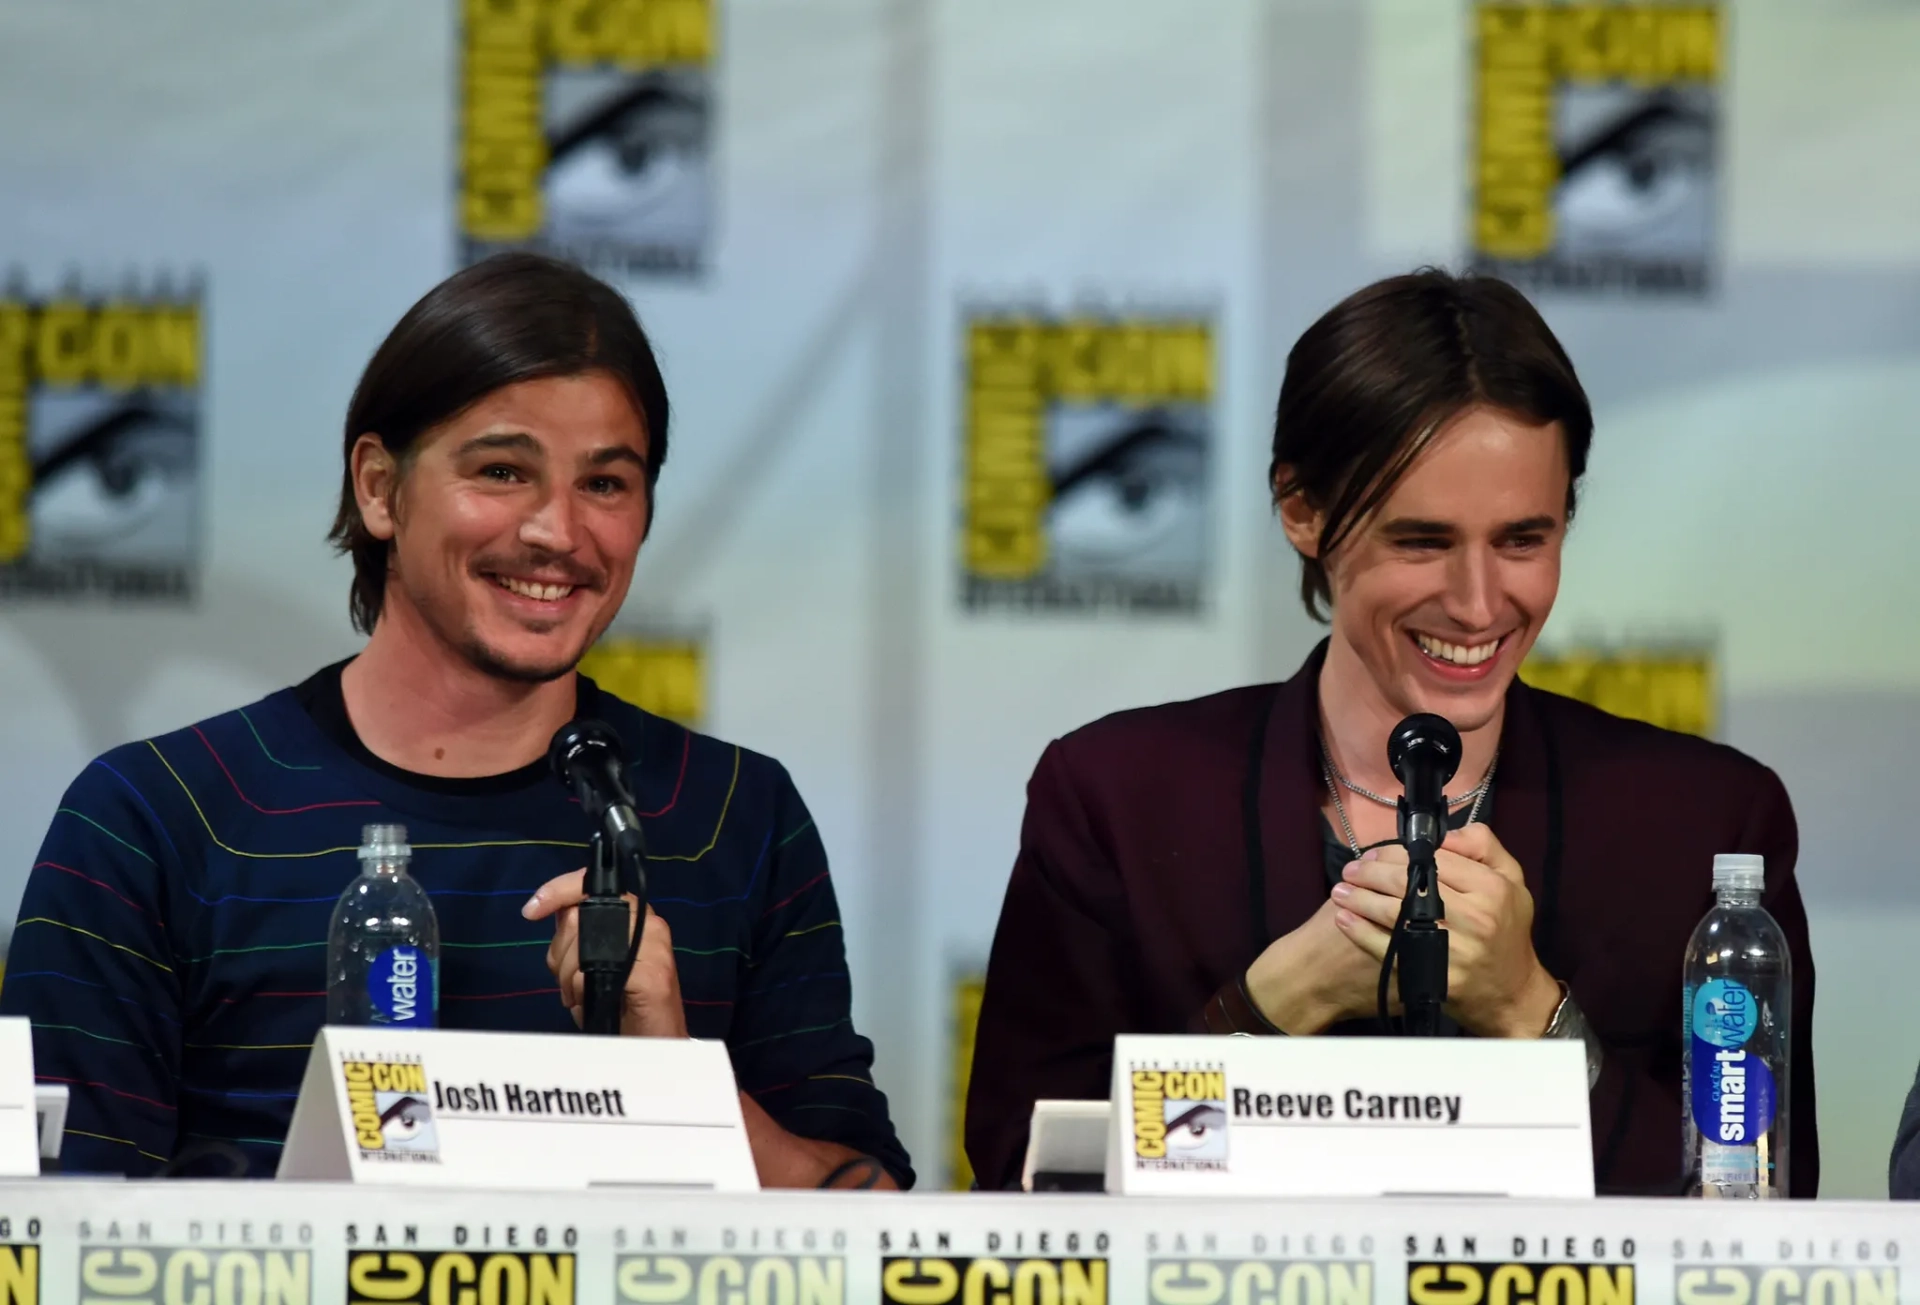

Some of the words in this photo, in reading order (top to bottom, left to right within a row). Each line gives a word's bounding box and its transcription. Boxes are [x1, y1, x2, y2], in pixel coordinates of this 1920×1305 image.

[386, 948, 417, 1021] water
[1717, 979, 1747, 1050] water
[372, 1062, 427, 1094] CON
[1164, 1071, 1226, 1101] CON
[1715, 1050, 1746, 1142] smart
[343, 1062, 384, 1149] COMIC
[434, 1080, 498, 1111] Josh
[504, 1083, 625, 1117] Hartnett
[1132, 1070, 1167, 1159] COMIC
[1232, 1088, 1333, 1118] Reeve
[1344, 1089, 1461, 1125] Carney
[347, 1224, 417, 1246] SAN
[455, 1226, 577, 1248] DIEGO
[879, 1231, 950, 1251] SAN
[988, 1232, 1109, 1252] DIEGO
[1405, 1236, 1476, 1257] SAN
[1513, 1237, 1635, 1258] DIEGO
